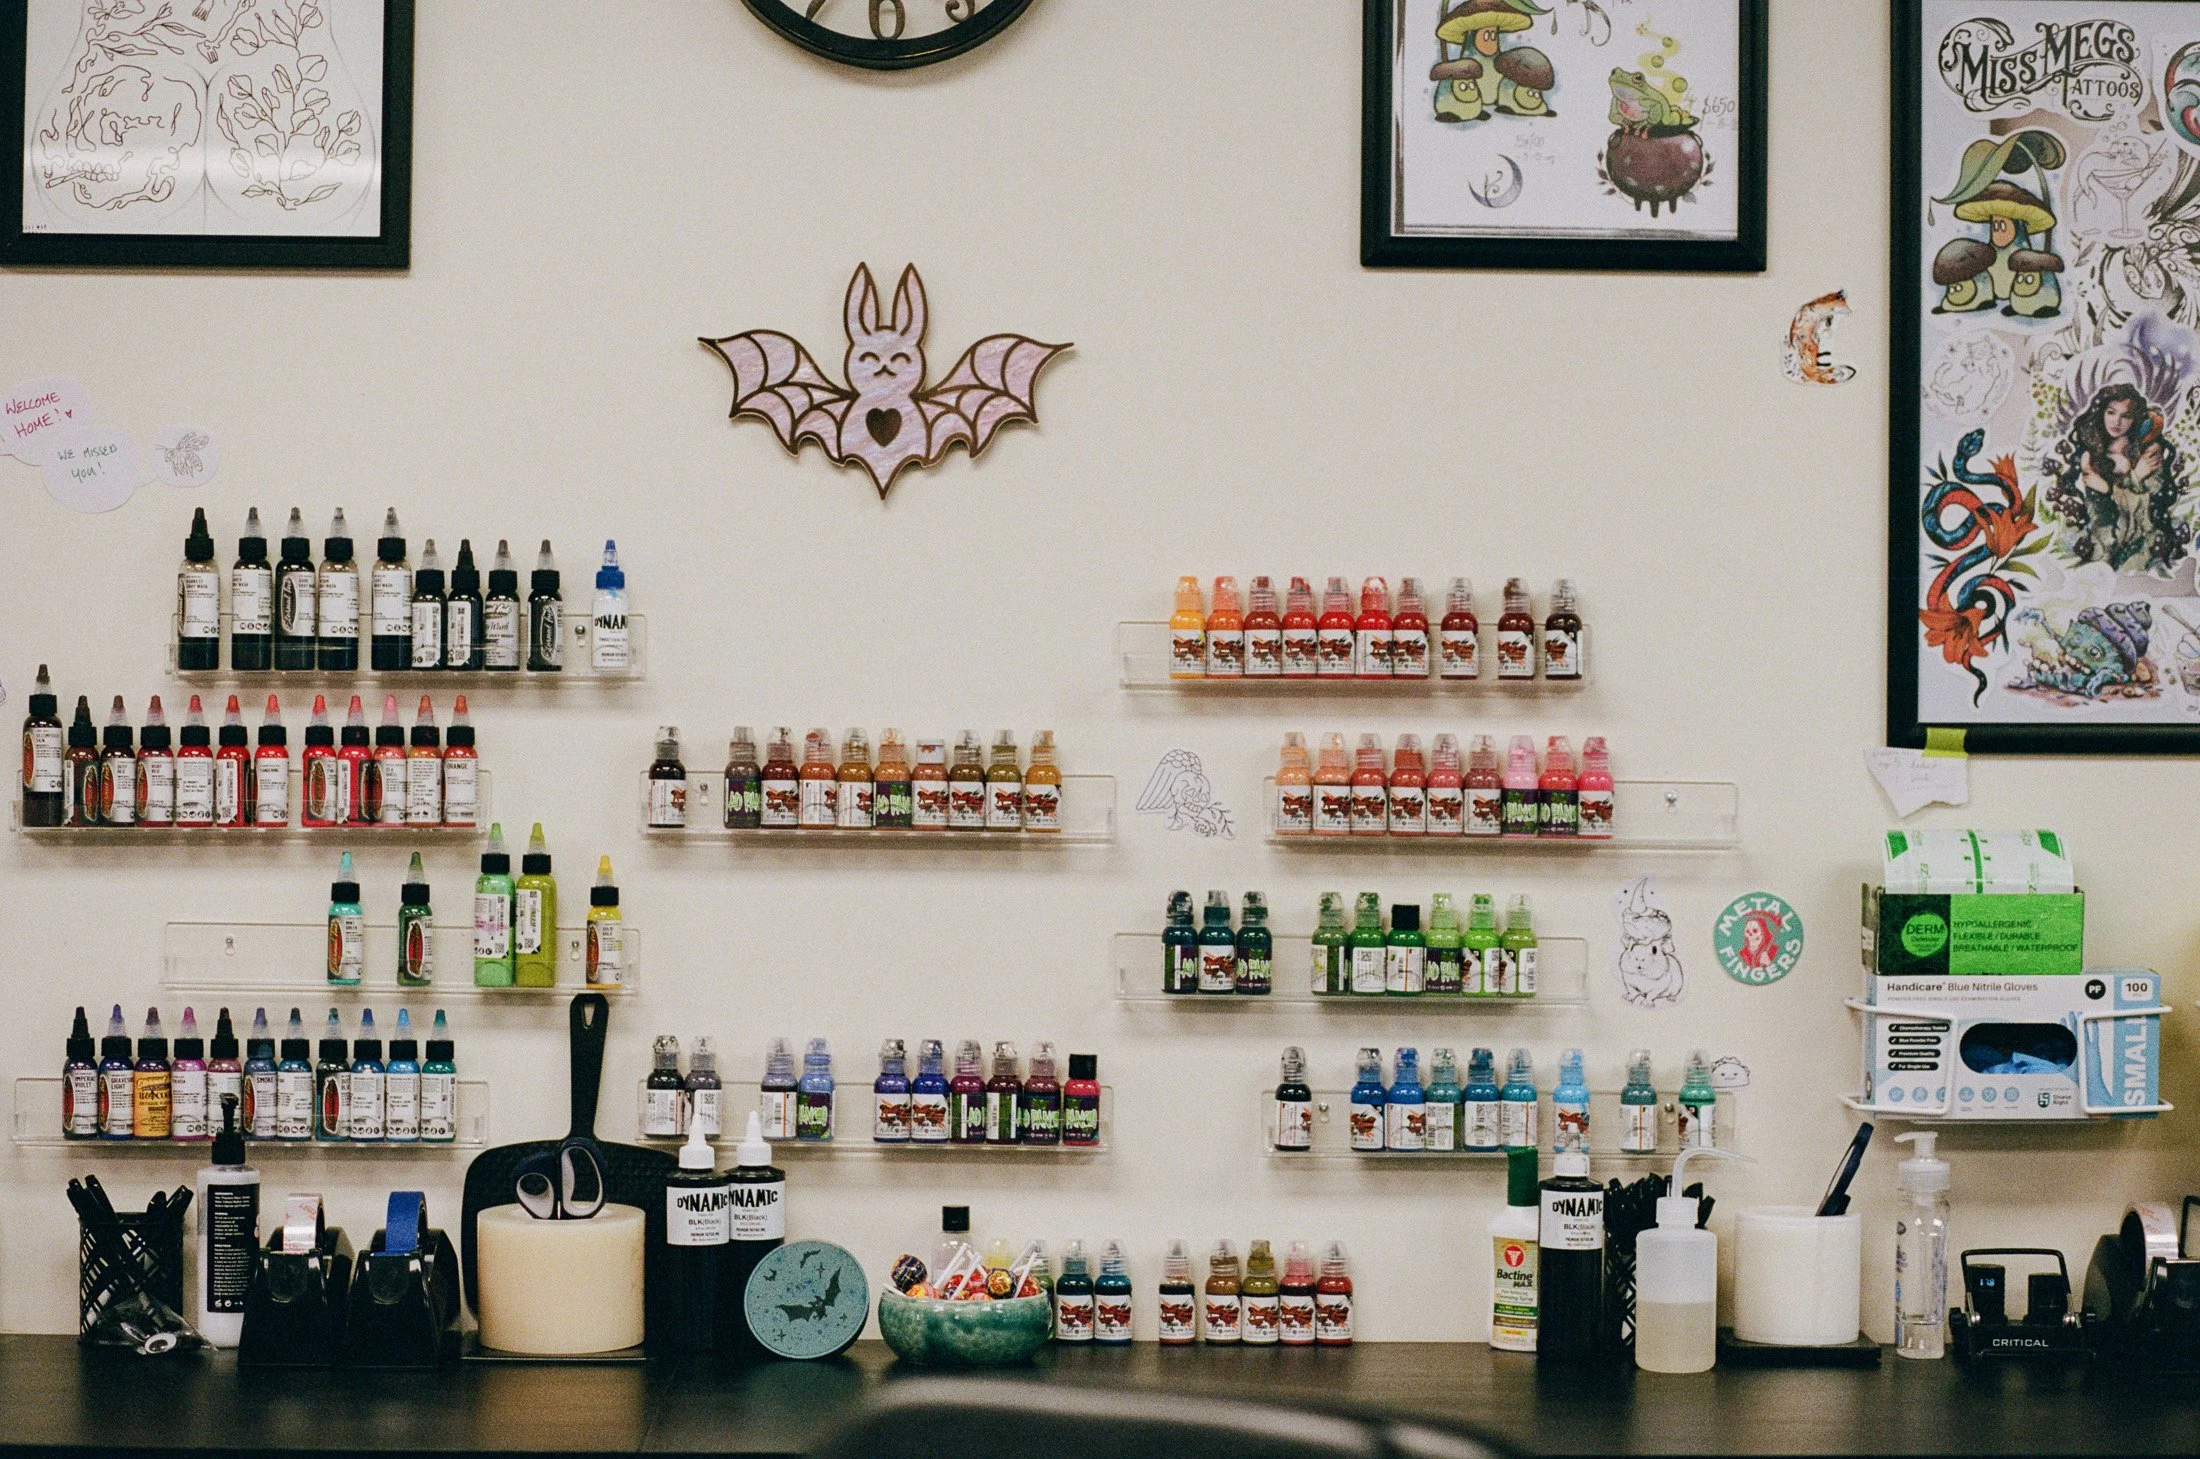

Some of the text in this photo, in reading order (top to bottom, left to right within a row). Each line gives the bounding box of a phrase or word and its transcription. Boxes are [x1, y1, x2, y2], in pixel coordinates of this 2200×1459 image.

[1944, 22, 2135, 101] MISS MEGS
[2061, 72, 2140, 107] TATTOOS
[6, 391, 61, 415] WELCOME
[14, 408, 62, 438] HOME!
[58, 443, 118, 461] WE MISSED
[594, 614, 628, 630] DYNAM
[1719, 897, 1794, 937] METAL
[1953, 920, 2032, 929] HYPOALLERGENIC
[1906, 924, 1944, 934] DERM
[1953, 932, 1993, 940] FLEXIBLE
[2000, 932, 2041, 940] DURABLE
[2016, 943, 2078, 951] WATERPROOF
[1719, 939, 1801, 981] FINGERS
[1948, 982, 1970, 992] Blue
[1972, 982, 2002, 992] Nitrile
[2003, 982, 2038, 992] Gloves
[2089, 984, 2103, 994] PF
[2126, 982, 2148, 992] 100
[677, 1192, 729, 1212] DYNAMIC
[729, 1188, 778, 1208] YNAMIC
[1552, 1197, 1603, 1217] DYNAMIC
[1496, 1268, 1533, 1281] Bactine
[1992, 1338, 2049, 1347] CRITICAL
